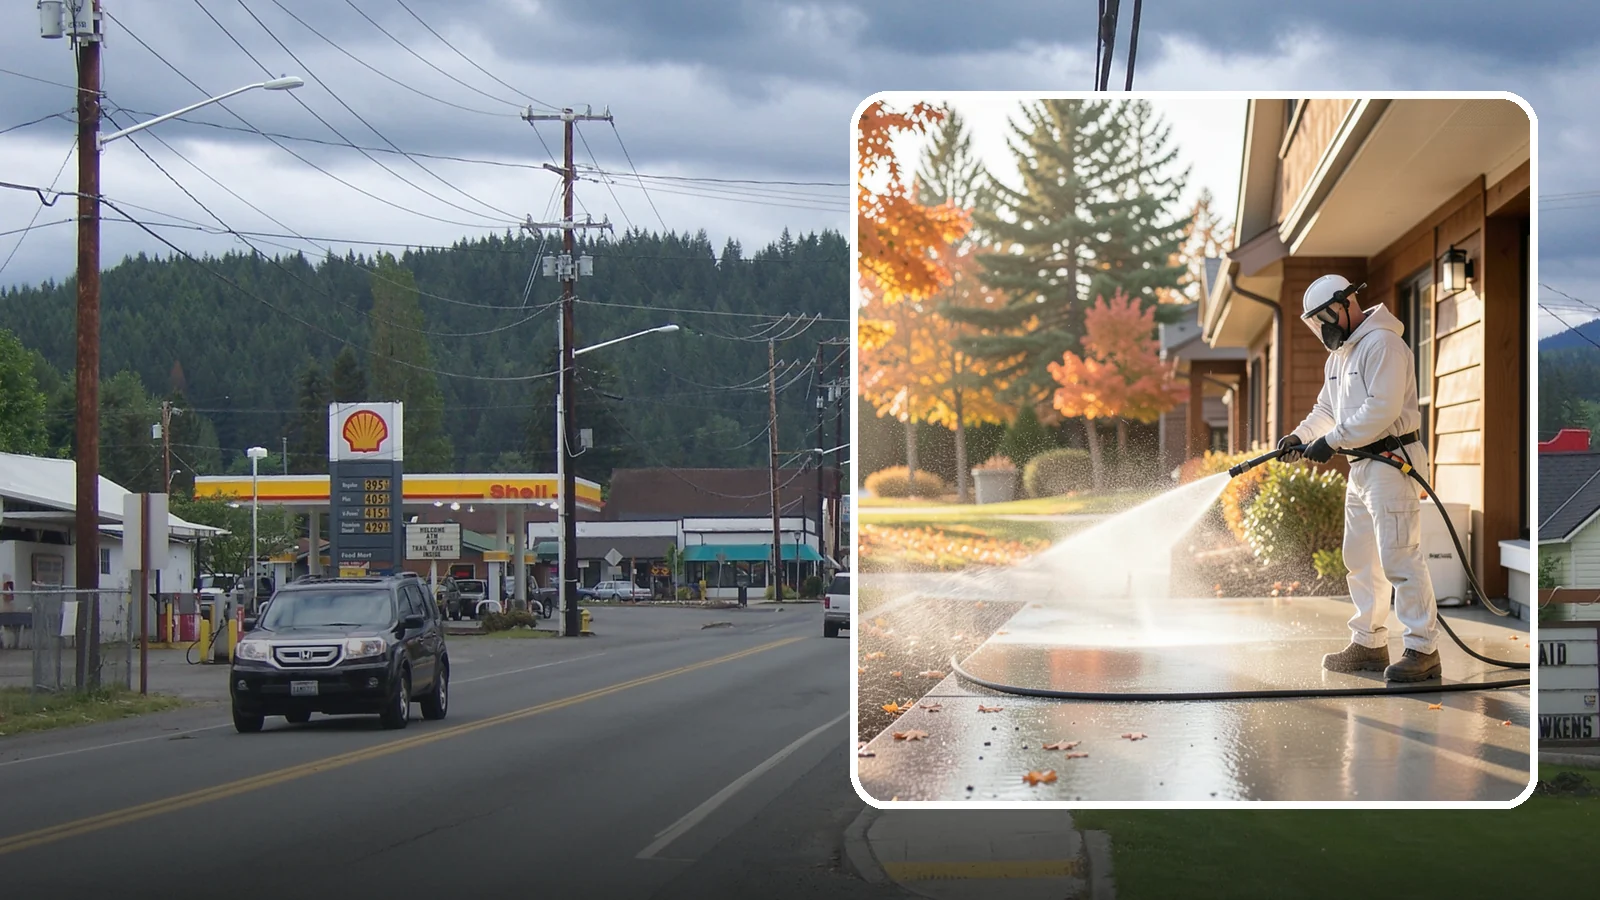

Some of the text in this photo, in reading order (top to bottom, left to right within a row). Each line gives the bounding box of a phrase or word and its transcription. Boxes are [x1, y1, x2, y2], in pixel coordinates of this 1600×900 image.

[366, 480, 383, 490] 395
[490, 484, 547, 499] Shell
[366, 494, 383, 504] 405
[366, 508, 383, 518] 415
[366, 522, 383, 532] 429
[1538, 643, 1566, 665] AID
